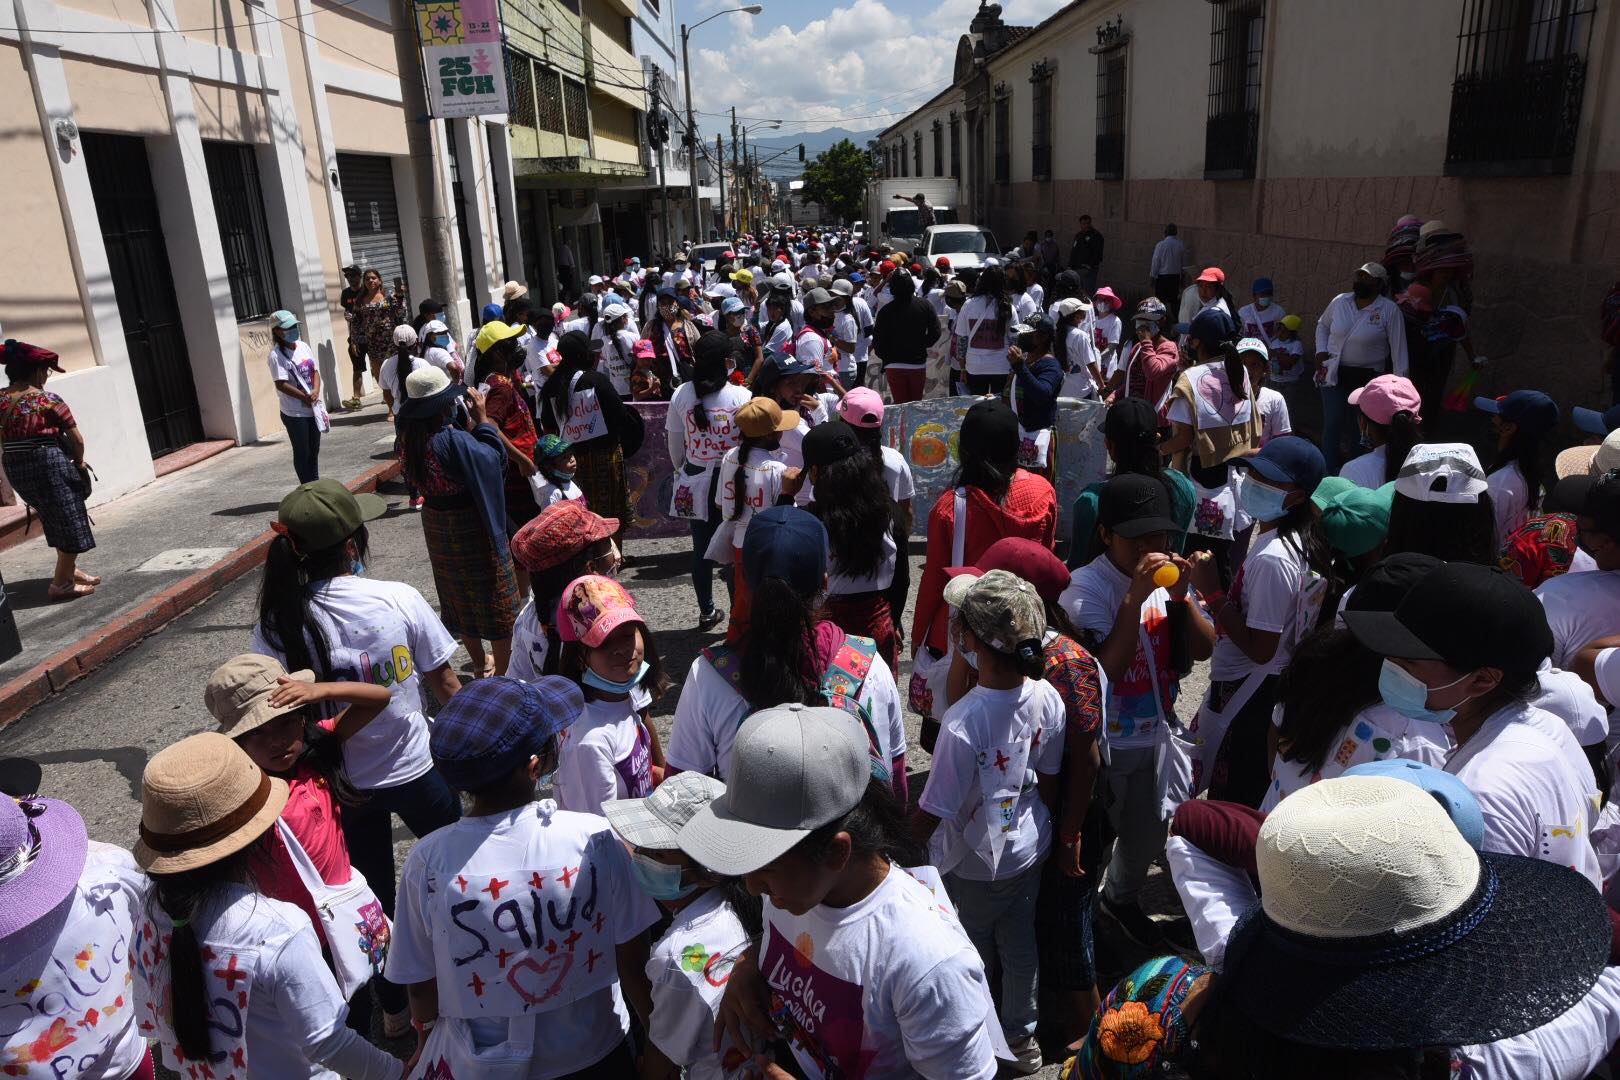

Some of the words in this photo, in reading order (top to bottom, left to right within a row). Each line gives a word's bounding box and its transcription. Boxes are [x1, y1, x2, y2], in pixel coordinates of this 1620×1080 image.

[439, 57, 472, 76] 25
[441, 76, 495, 96] FCH
[687, 409, 731, 435] Slud
[723, 481, 764, 508] Sud
[451, 862, 597, 967] Salud
[768, 953, 826, 1023] Lucha
